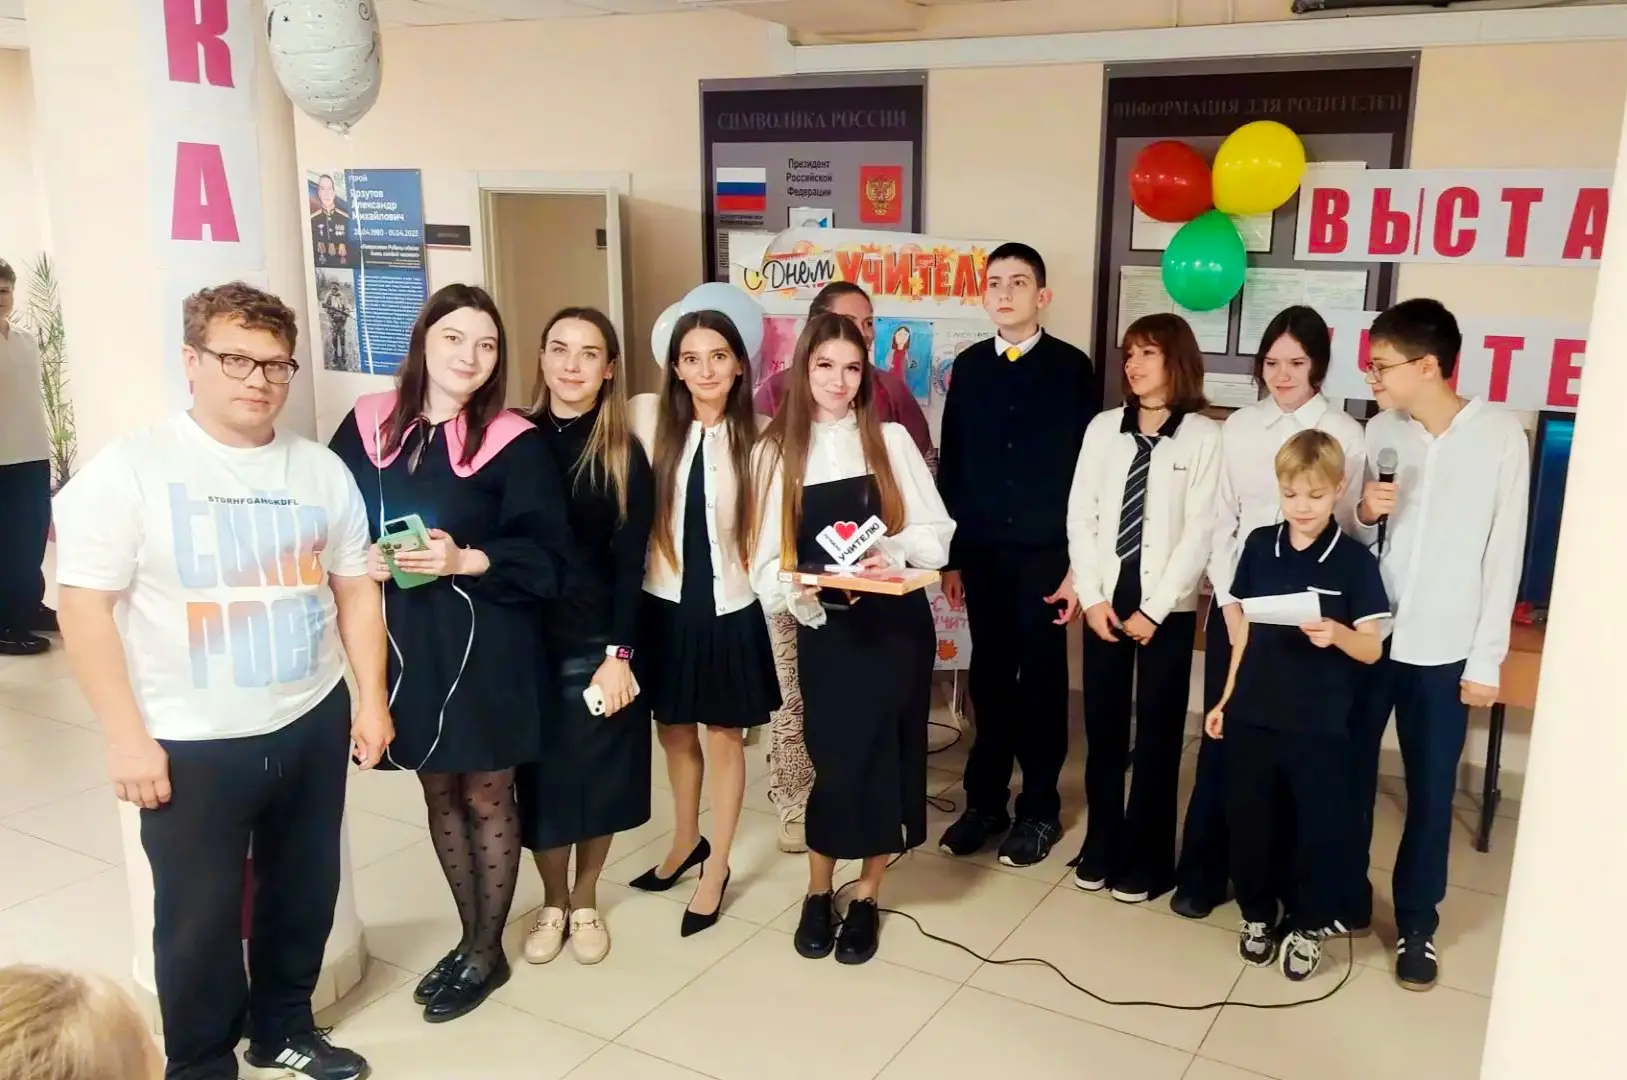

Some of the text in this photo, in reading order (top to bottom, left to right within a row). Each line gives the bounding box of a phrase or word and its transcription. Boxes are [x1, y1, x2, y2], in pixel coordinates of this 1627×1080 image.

[717, 108, 908, 130] СИМВОЛИКА РОССИИ
[1113, 99, 1239, 119] ИНФОРМАЦИЯ
[1244, 97, 1281, 116] ДЛЯ
[788, 158, 831, 169] Президент
[786, 171, 832, 183] Российской
[787, 185, 832, 197] Федерации
[835, 250, 987, 297] УЧИТЕЛ
[838, 521, 880, 562] УЧИТЕЛЮ
